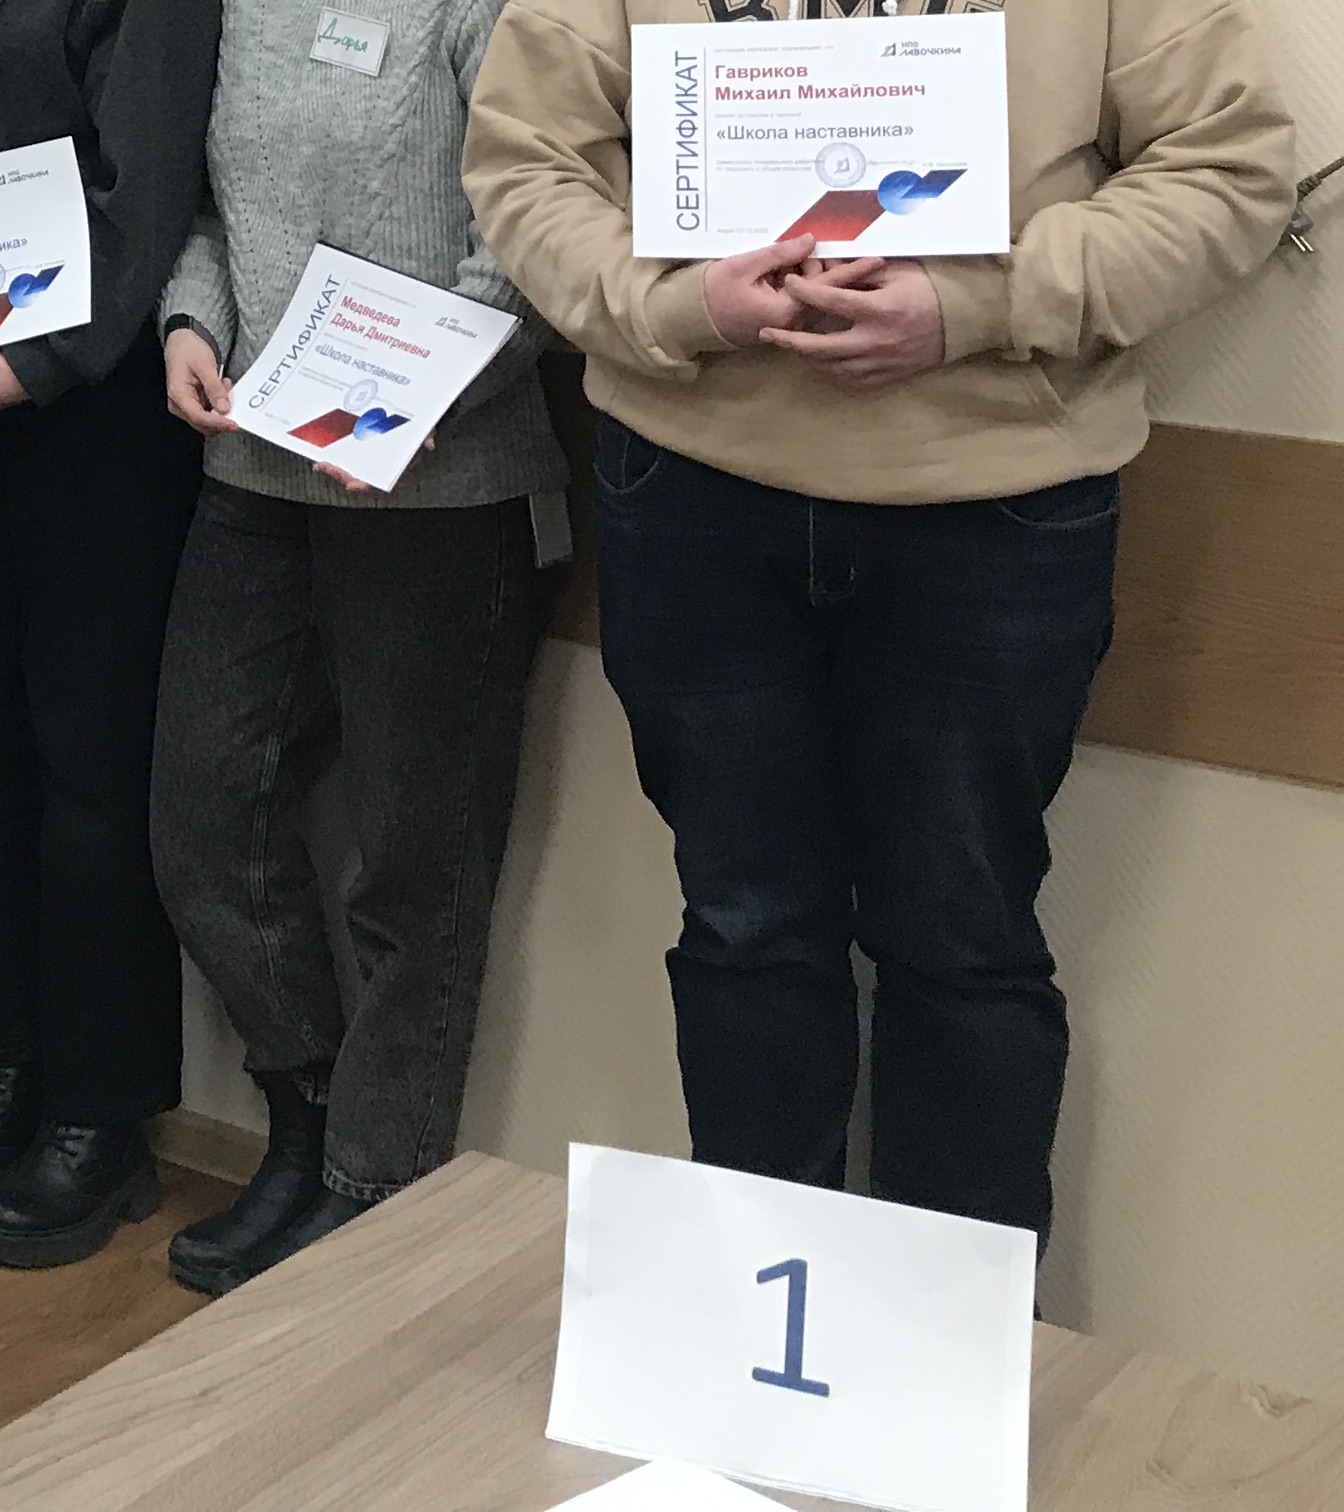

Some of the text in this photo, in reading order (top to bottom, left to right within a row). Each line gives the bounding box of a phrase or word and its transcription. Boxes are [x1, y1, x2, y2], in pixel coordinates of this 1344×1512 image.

[715, 65, 808, 81] Гавриков
[715, 83, 926, 101] Михаил Михайлович
[675, 50, 700, 231] СЕРТИФИКАТ
[716, 123, 914, 141] «Школа наставника»
[340, 294, 401, 328] Медведева
[248, 273, 341, 410] СЕРТИФИКАТ
[330, 312, 365, 335] Дарья
[363, 324, 431, 360] Дмитриевна
[752, 1257, 830, 1399] 1
